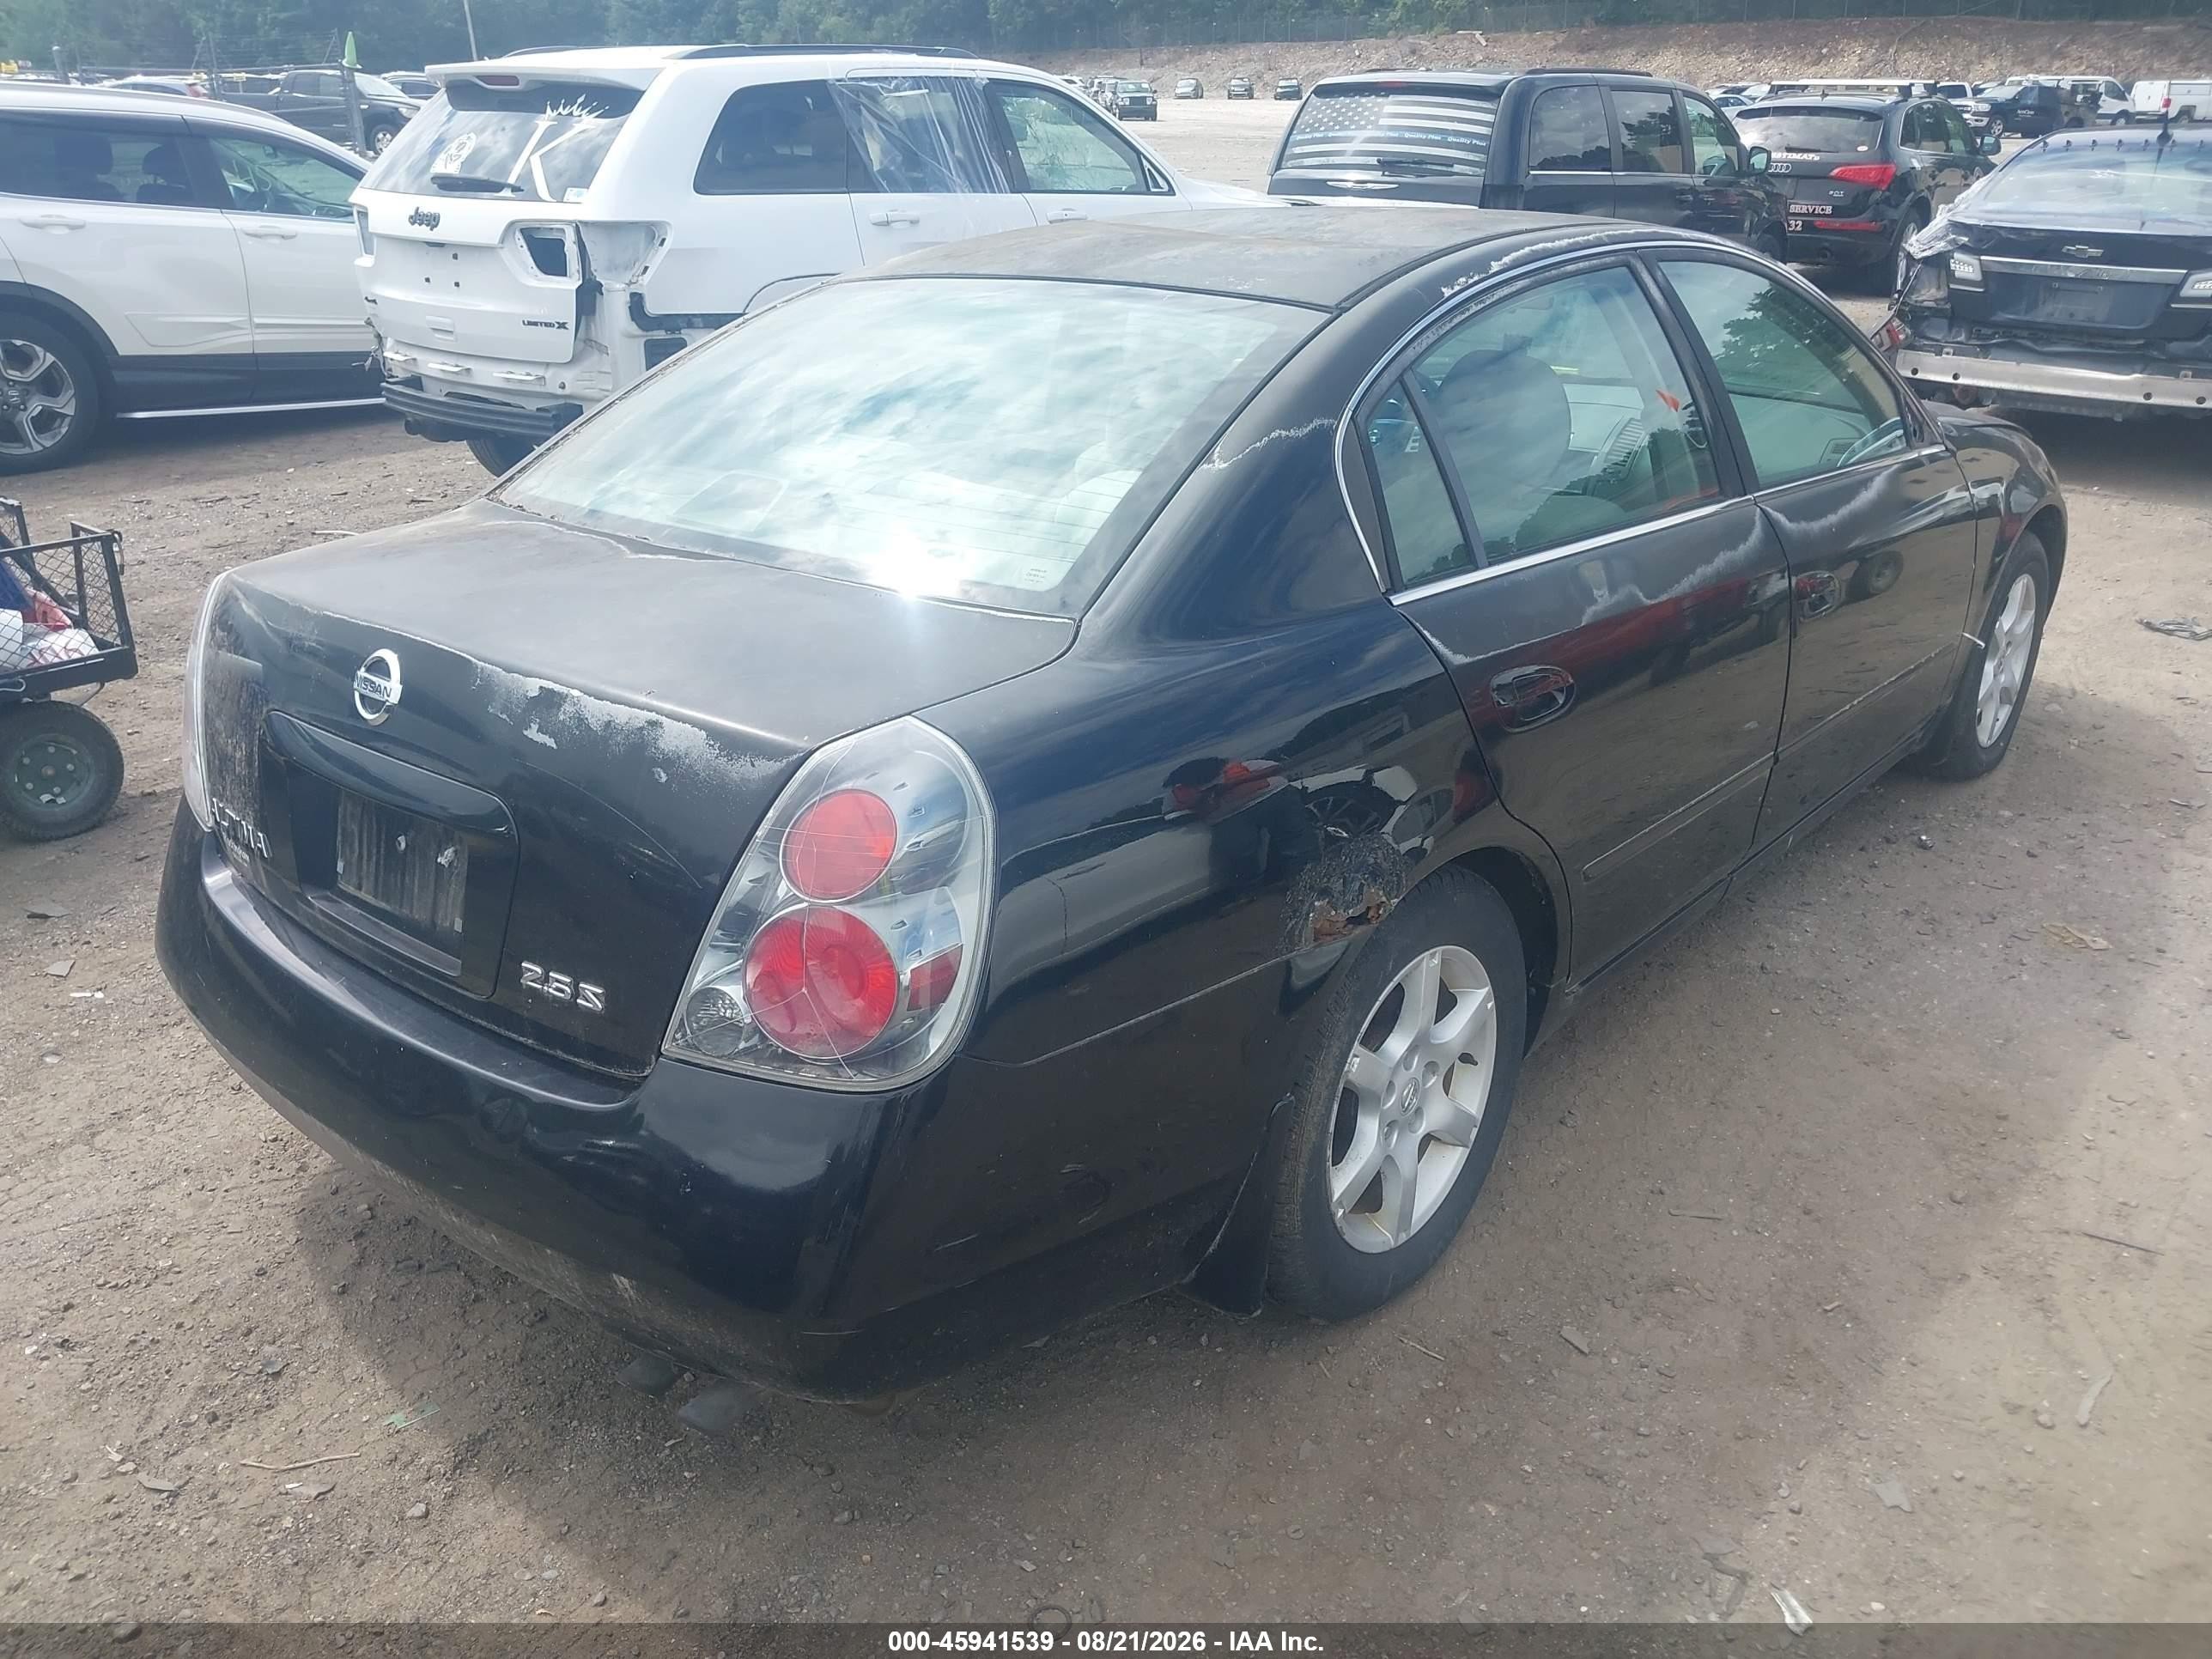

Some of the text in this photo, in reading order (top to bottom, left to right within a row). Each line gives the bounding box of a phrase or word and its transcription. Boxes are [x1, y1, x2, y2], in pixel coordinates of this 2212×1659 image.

[495, 120, 597, 203] K
[408, 206, 441, 231] Jeep
[1789, 204, 1832, 215] SERVICE
[1788, 220, 1802, 231] 32
[355, 671, 392, 698] NISSAN
